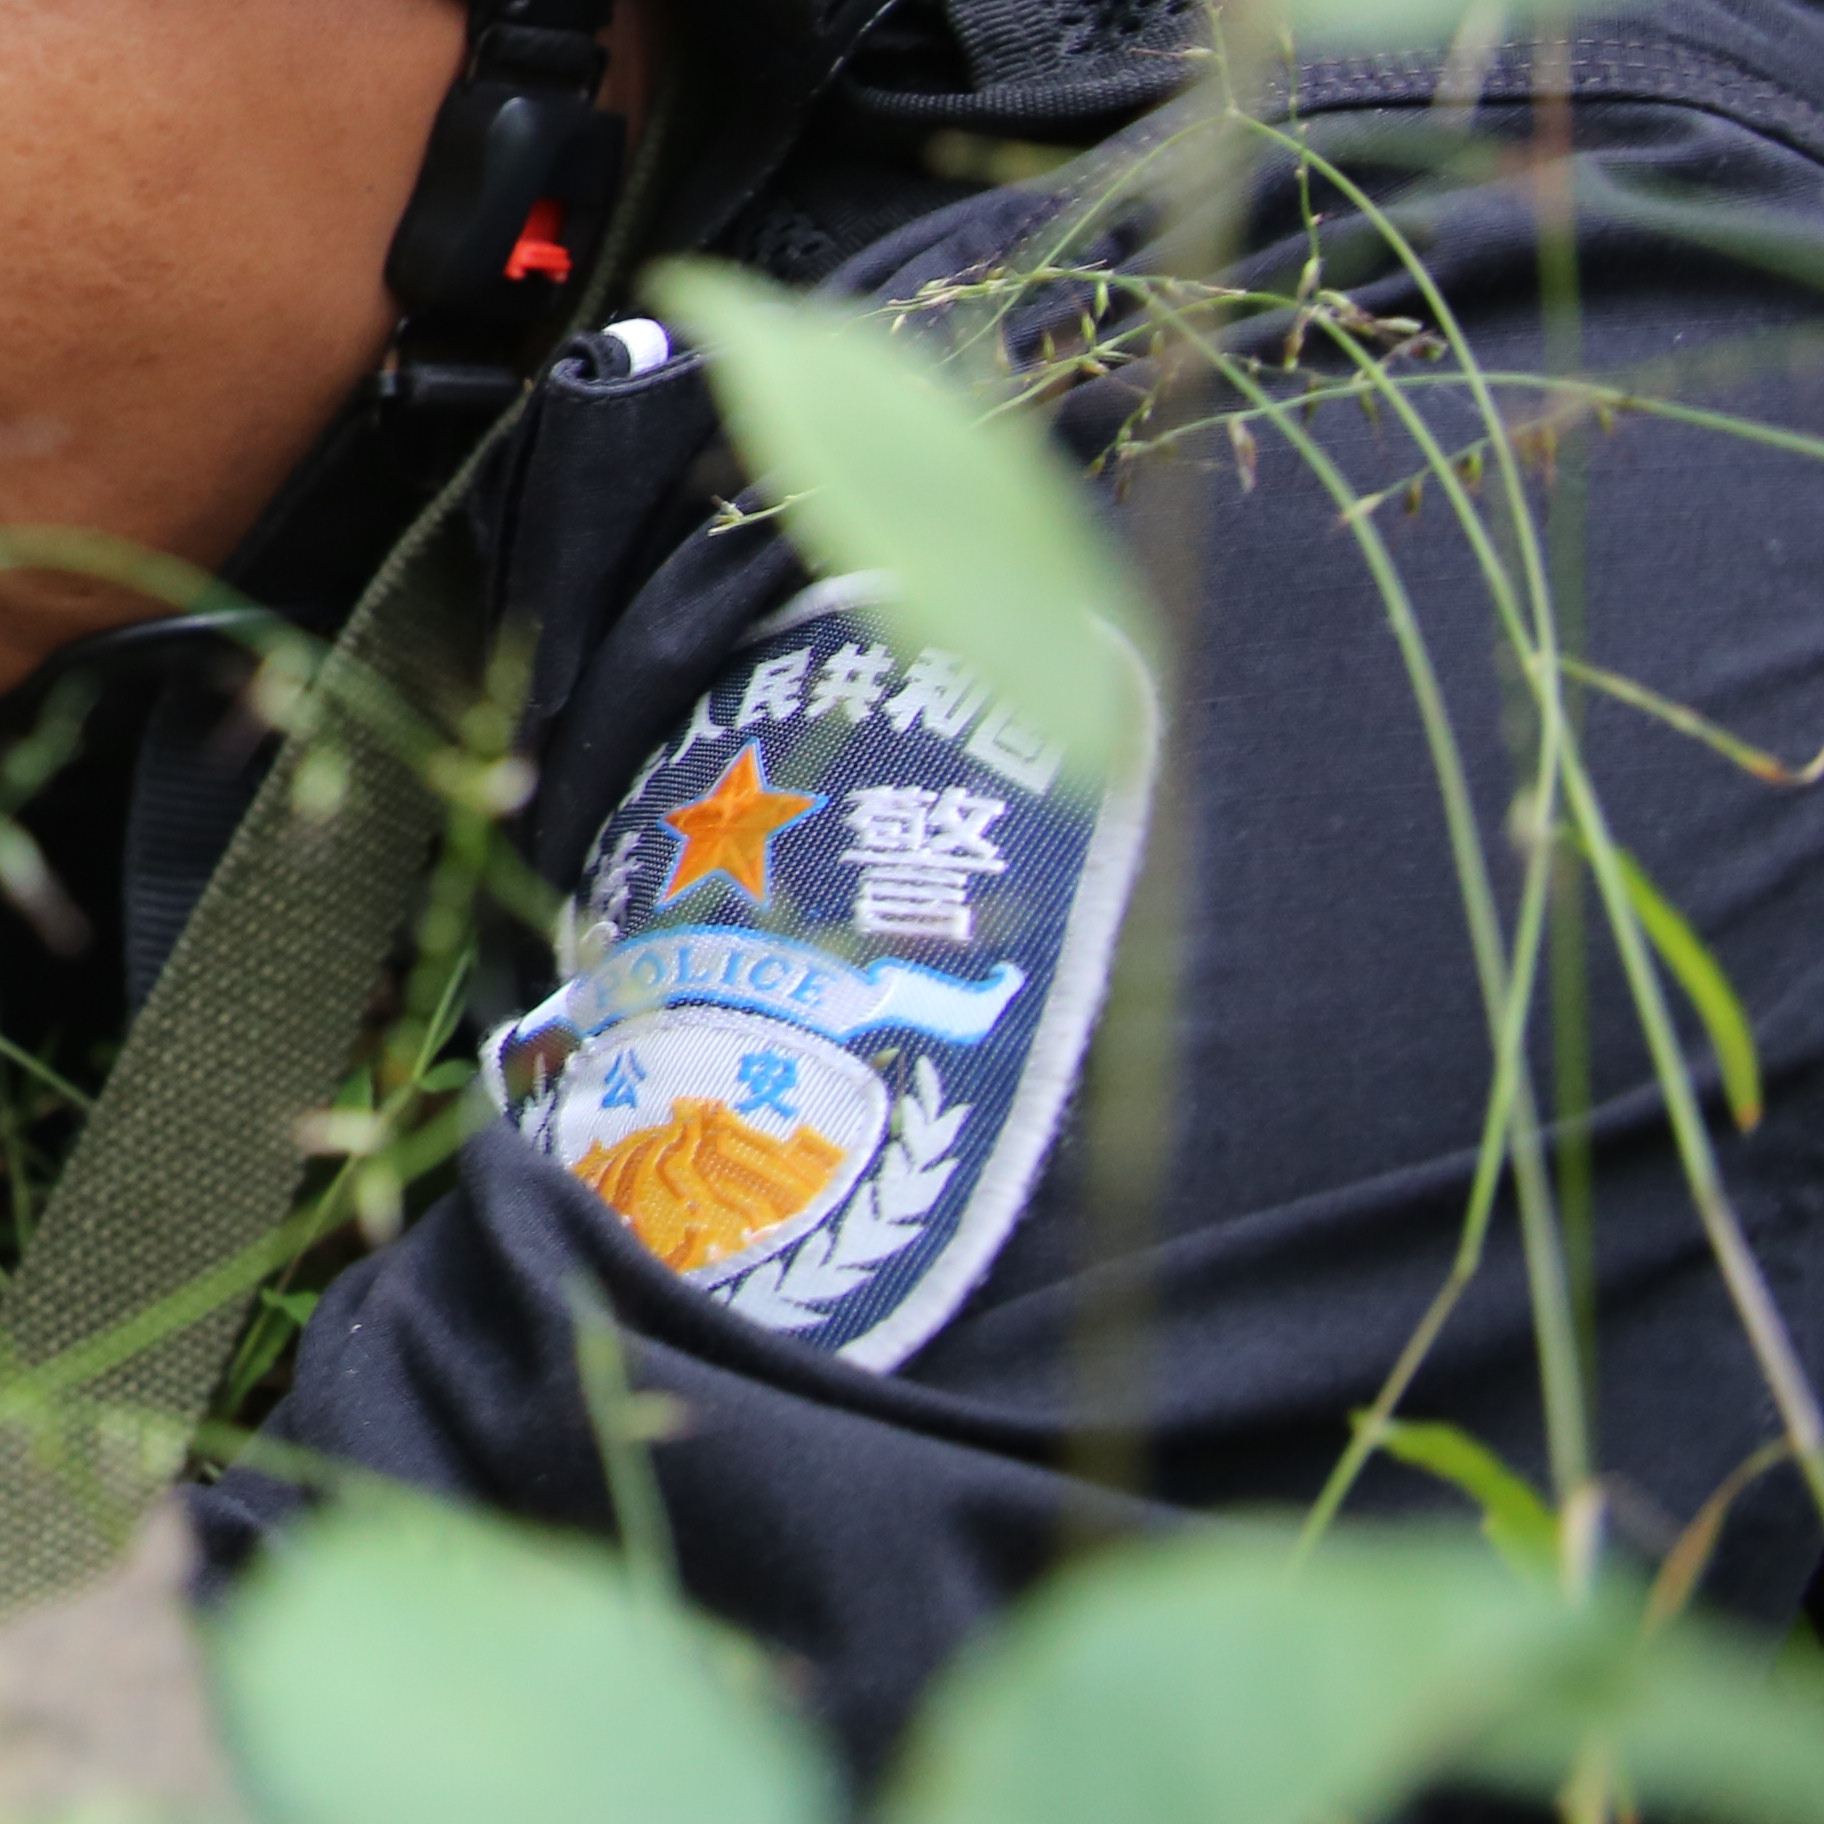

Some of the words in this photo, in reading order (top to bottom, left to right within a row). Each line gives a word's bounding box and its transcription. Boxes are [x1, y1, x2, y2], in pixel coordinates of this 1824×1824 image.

[635, 641, 1066, 808] 人民共和国
[840, 785, 1009, 942] 警
[595, 943, 826, 1010] POLICE
